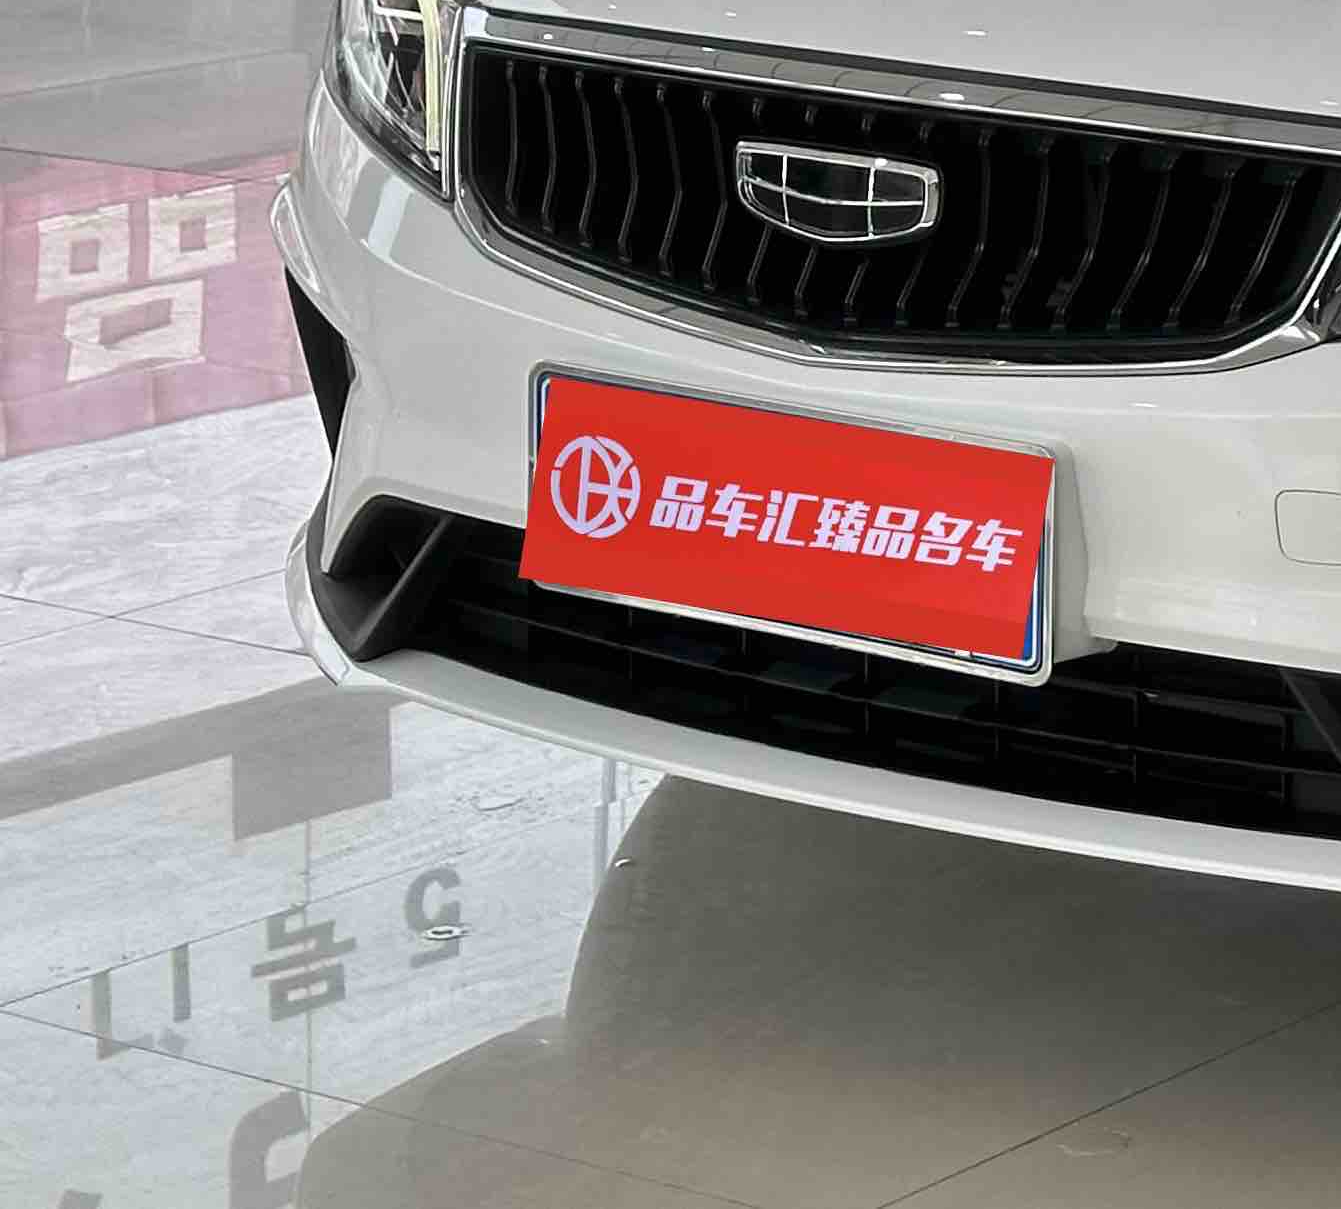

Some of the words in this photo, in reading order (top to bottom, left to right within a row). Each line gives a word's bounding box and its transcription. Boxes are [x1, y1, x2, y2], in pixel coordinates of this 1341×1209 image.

[648, 474, 1024, 573] 品车汇臻品名车
